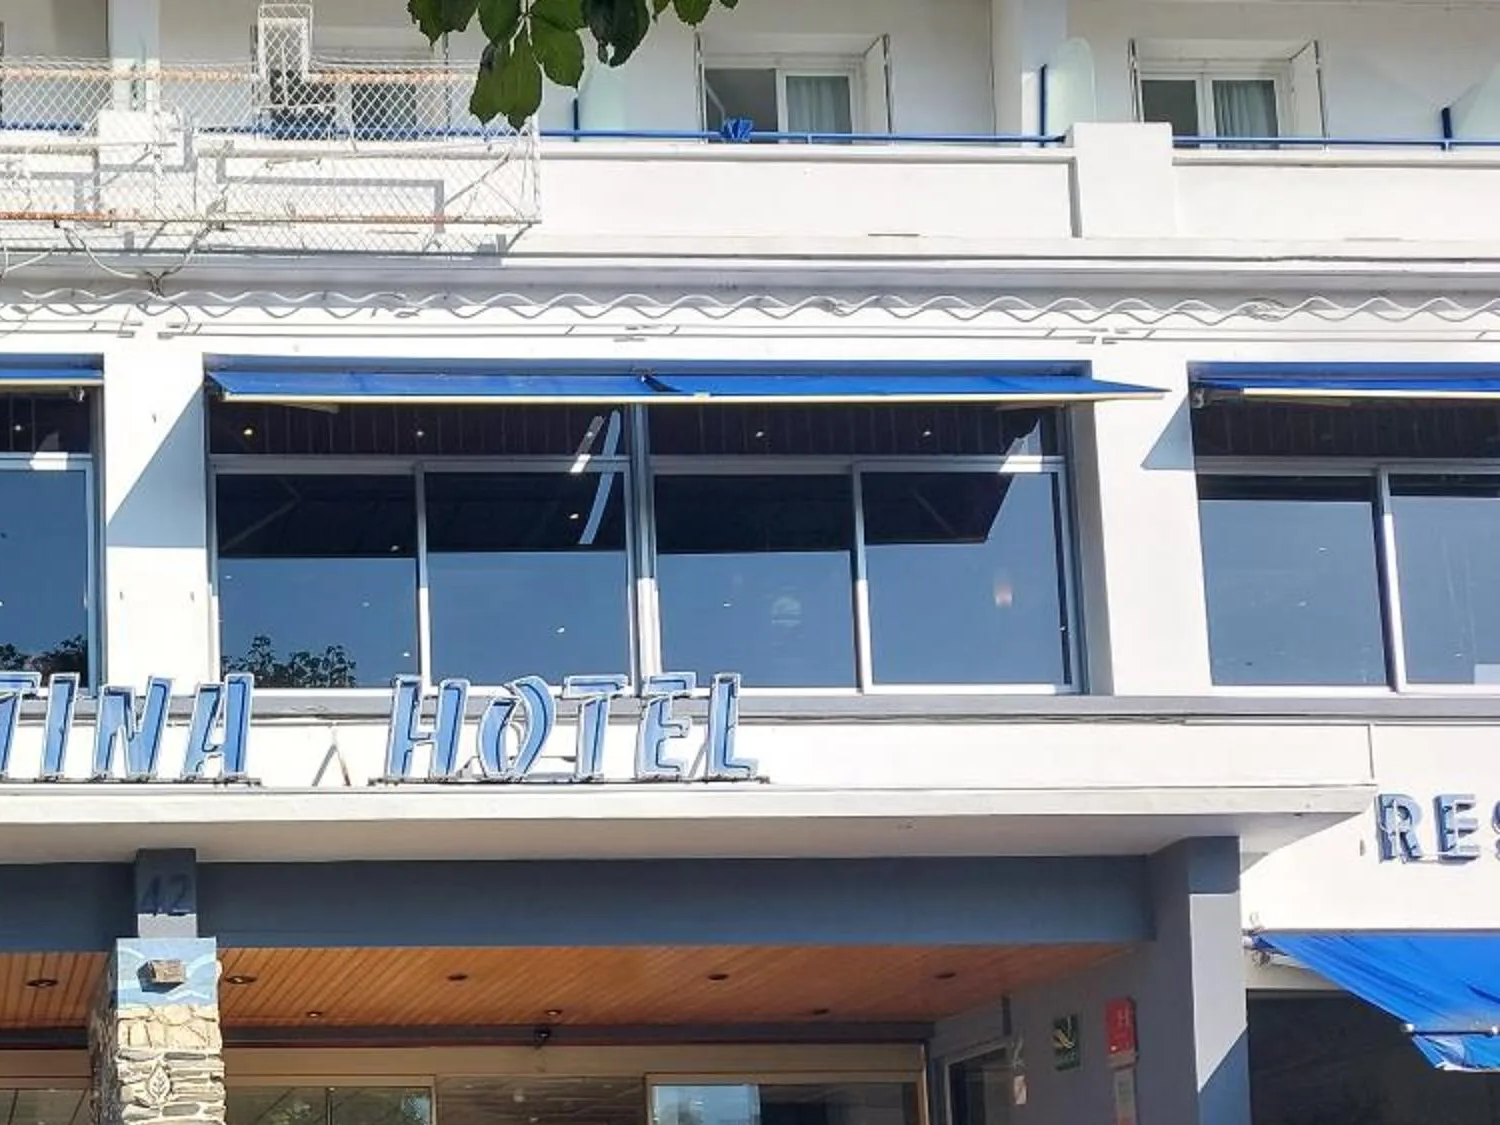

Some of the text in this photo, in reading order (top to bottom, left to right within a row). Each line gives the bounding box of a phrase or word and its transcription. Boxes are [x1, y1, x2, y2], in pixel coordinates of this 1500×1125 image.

[383, 671, 759, 780] HOTEL
[1374, 794, 1500, 864] RE
[141, 873, 192, 917] 42
